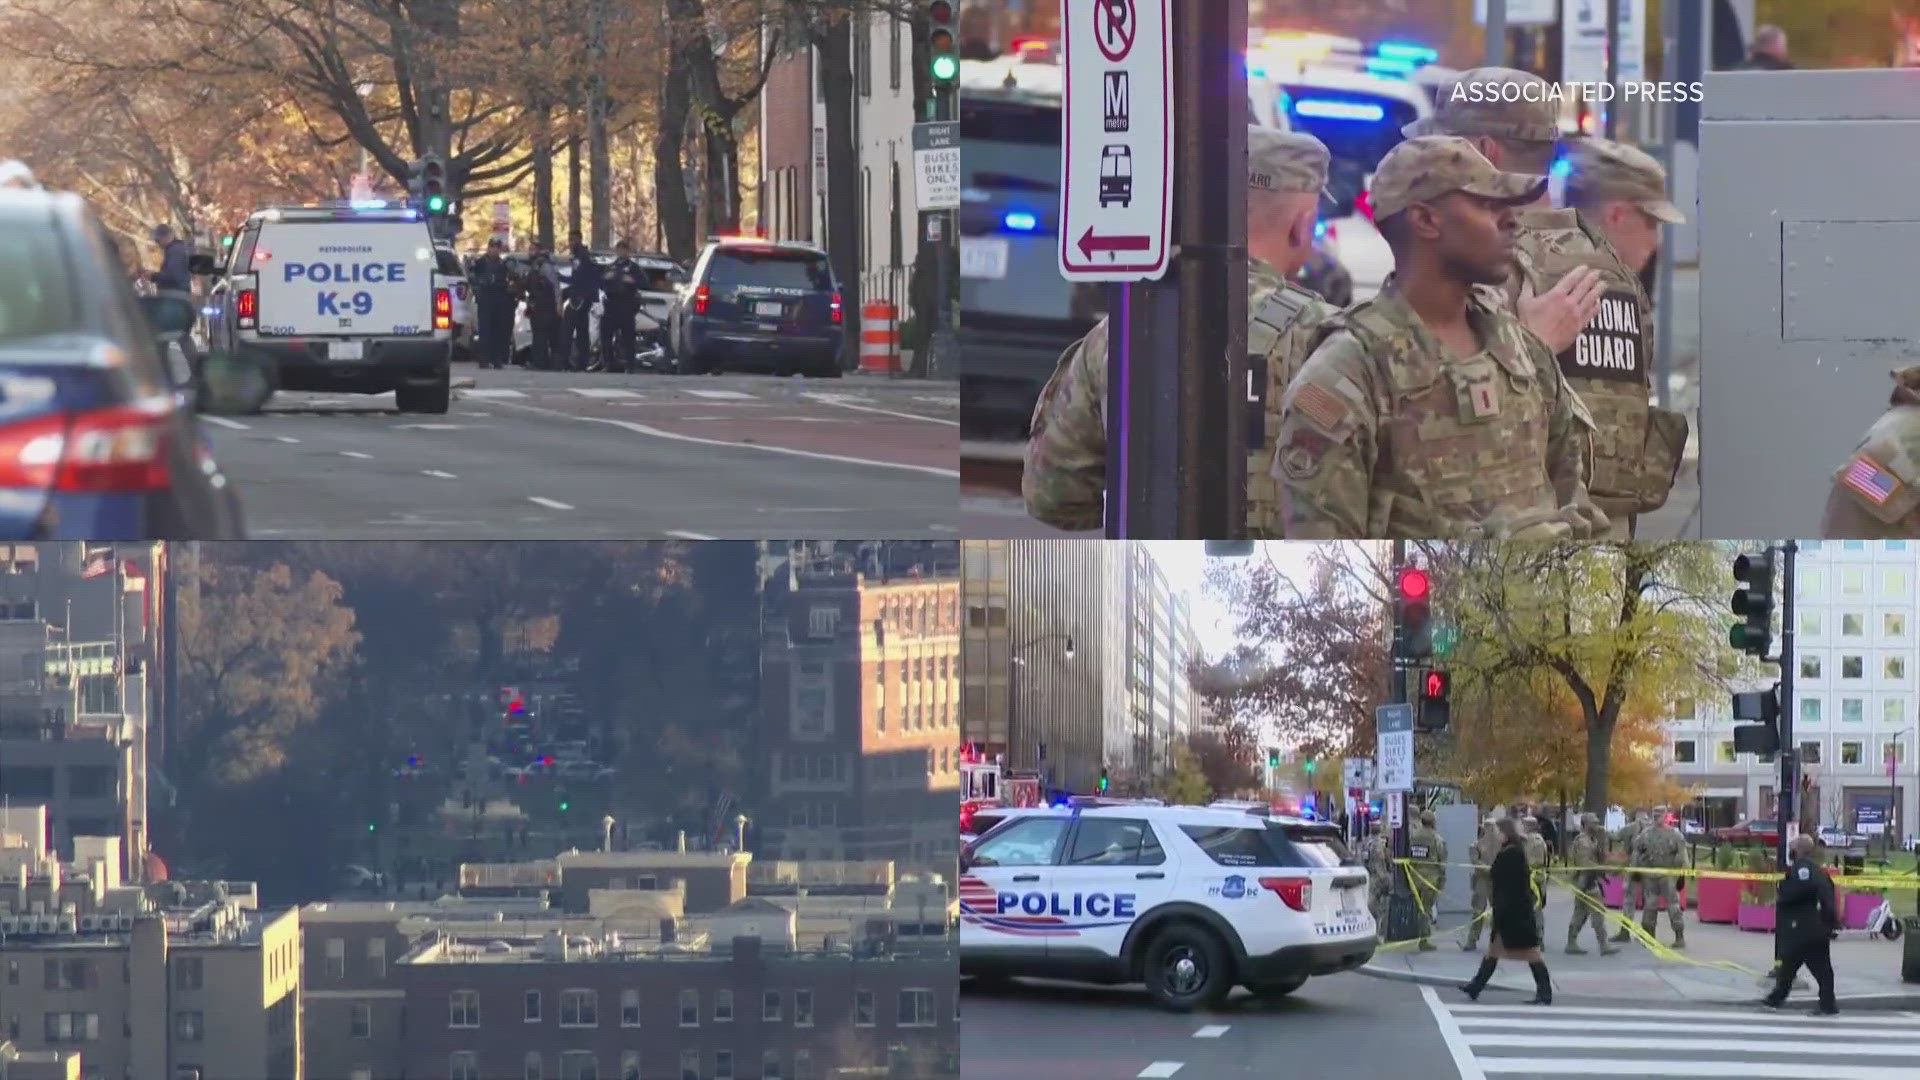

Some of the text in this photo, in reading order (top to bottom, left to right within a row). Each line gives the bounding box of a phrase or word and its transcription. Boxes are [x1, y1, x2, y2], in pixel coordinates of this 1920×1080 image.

[1105, 74, 1127, 116] M
[1105, 118, 1127, 128] metro
[928, 126, 950, 135] RIGHT
[930, 137, 950, 146] LANE
[924, 152, 959, 164] BUSES
[925, 163, 959, 174] BIKES
[926, 174, 957, 184] ONLY
[1249, 172, 1272, 188] ARD
[284, 262, 406, 283] POLICE
[774, 287, 803, 296] POLICE
[317, 291, 373, 316] K-9
[1576, 333, 1636, 371] GUARD
[998, 891, 1136, 918] POLICE
